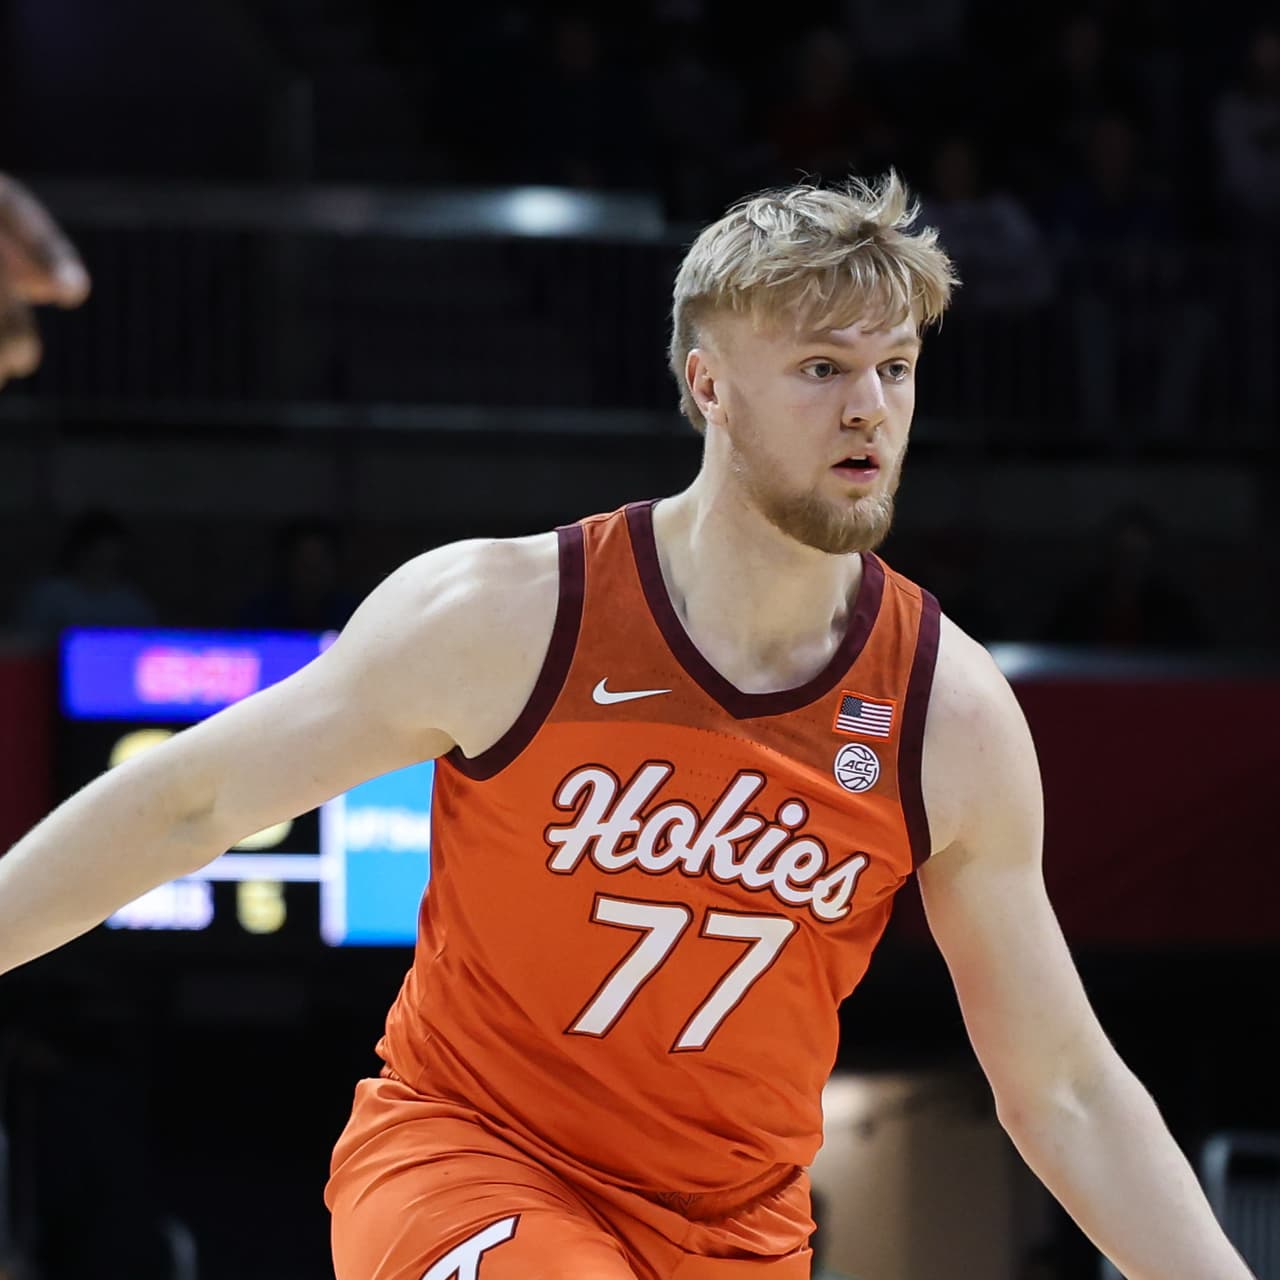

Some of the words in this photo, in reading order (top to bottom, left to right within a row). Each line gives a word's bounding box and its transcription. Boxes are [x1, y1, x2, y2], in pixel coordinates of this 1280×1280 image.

[545, 759, 870, 923] Hokies
[841, 759, 877, 774] ACC
[564, 892, 799, 1053] 77
